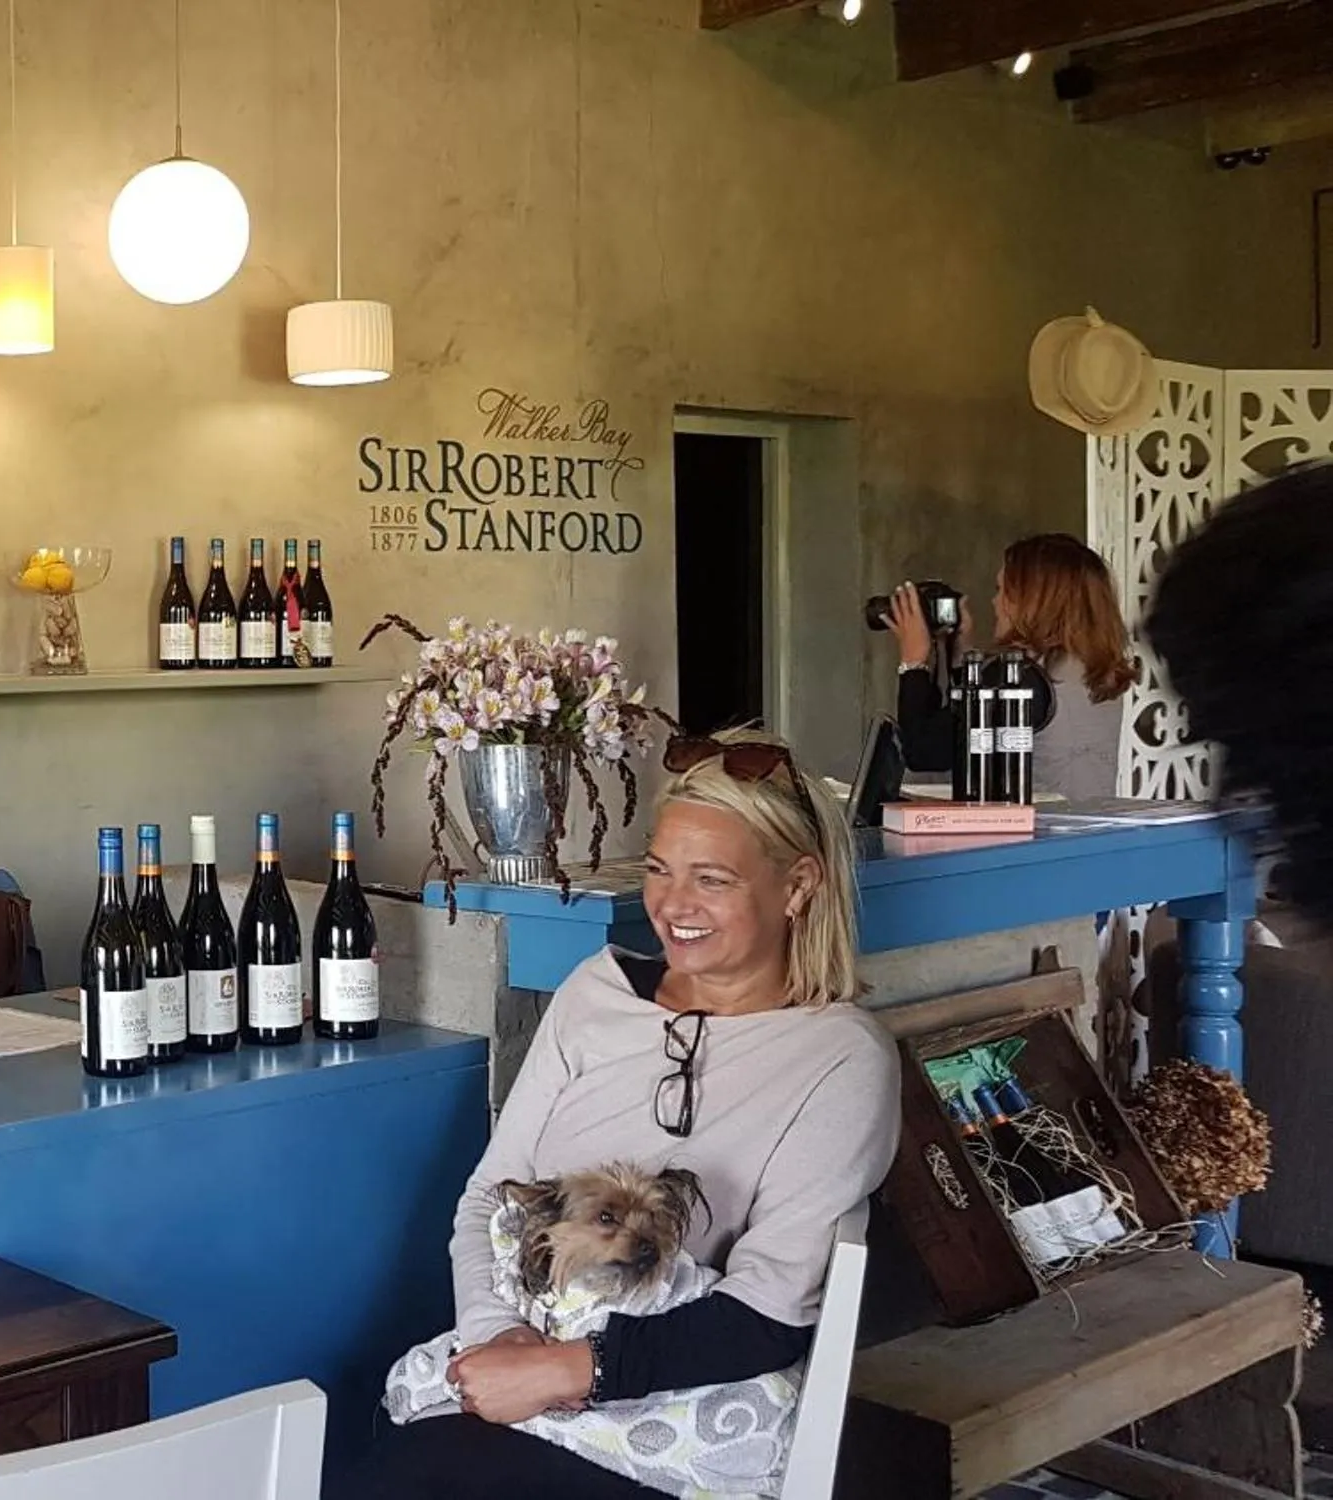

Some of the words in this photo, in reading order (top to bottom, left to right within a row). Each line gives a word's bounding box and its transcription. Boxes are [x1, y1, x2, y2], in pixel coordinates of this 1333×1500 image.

[477, 388, 572, 440] Walker
[371, 505, 417, 524] 1806
[425, 499, 642, 554] STANFORD
[371, 532, 418, 551] 1877
